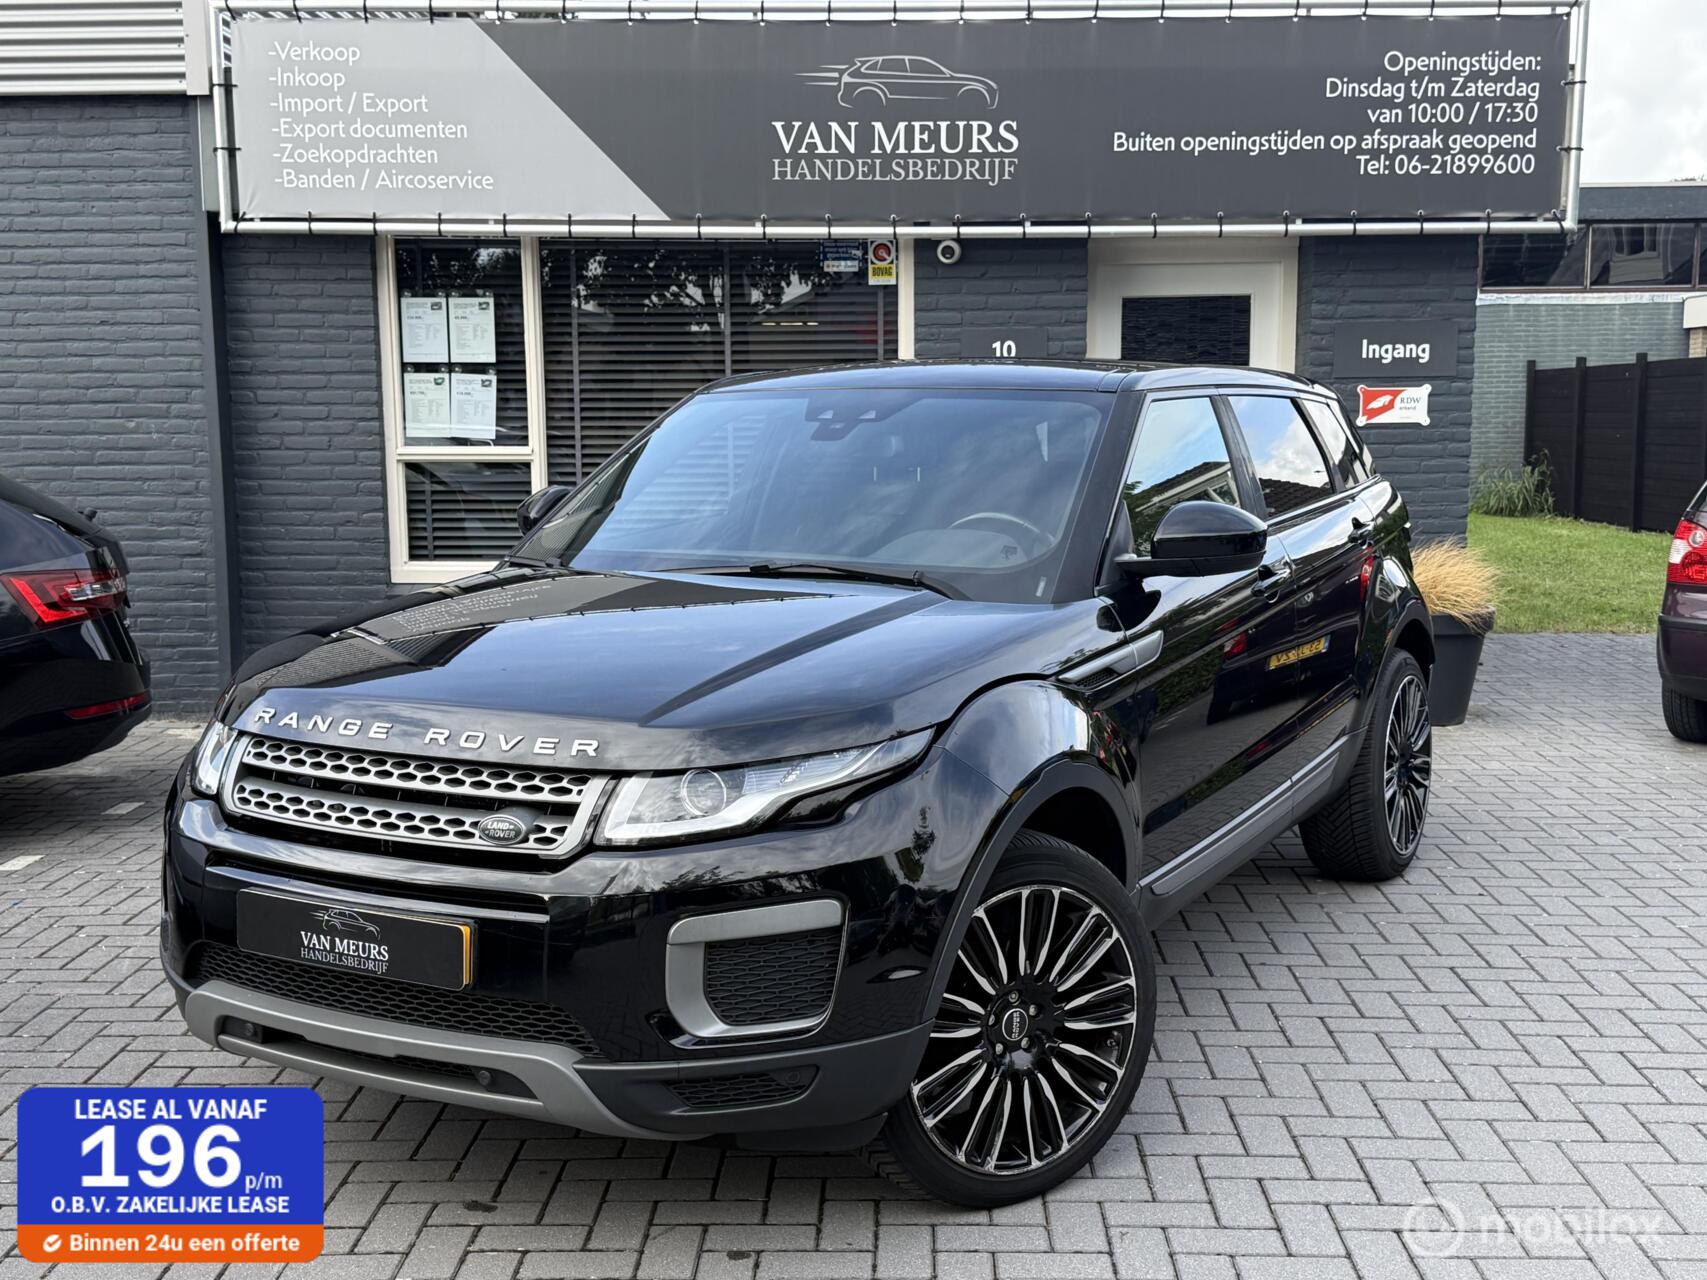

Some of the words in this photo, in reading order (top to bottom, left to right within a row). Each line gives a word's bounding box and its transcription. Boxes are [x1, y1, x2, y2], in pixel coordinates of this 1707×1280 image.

[268, 41, 361, 65] -Verkoop
[1383, 50, 1542, 75] Openingstijden:
[268, 67, 346, 90] -Inkoop
[1325, 78, 1404, 101] Dinsdag
[1410, 78, 1446, 98] t/m
[1450, 76, 1539, 101] Zaterdag
[270, 93, 343, 116] -Import
[348, 92, 357, 114] /
[362, 94, 428, 116] Export
[1367, 105, 1403, 124] van
[1408, 104, 1464, 123] 10:00
[1468, 102, 1480, 125] /
[1484, 103, 1538, 123] 17:30
[272, 119, 346, 142] -Export
[350, 119, 468, 139] documenten
[771, 121, 858, 154] VAN
[871, 120, 1019, 154] MEURS
[1113, 131, 1176, 152] Buiten
[1180, 130, 1325, 156] openingstijden
[1329, 134, 1357, 155] op
[1361, 129, 1444, 152] afspraak
[1448, 128, 1537, 154] geopend
[273, 144, 438, 167] -Zoekopdrachten
[1356, 155, 1391, 176] Tel:
[1395, 154, 1535, 175] 06-21899600
[274, 169, 355, 189] -Banden
[360, 169, 370, 191] /
[375, 170, 494, 191] Aircoservice
[772, 158, 1018, 186] HANDELSBEDRIJF
[872, 266, 892, 277] BOVAG
[992, 340, 1016, 357] 10
[1362, 339, 1430, 363] Ingang
[254, 708, 393, 740] RANGE
[424, 728, 600, 757] ROVER
[487, 821, 509, 829] LAND
[489, 830, 515, 838] ROVER
[300, 931, 330, 951] VAN
[335, 937, 388, 961] MEURS
[301, 947, 388, 974] HANDELSBEDRIJF
